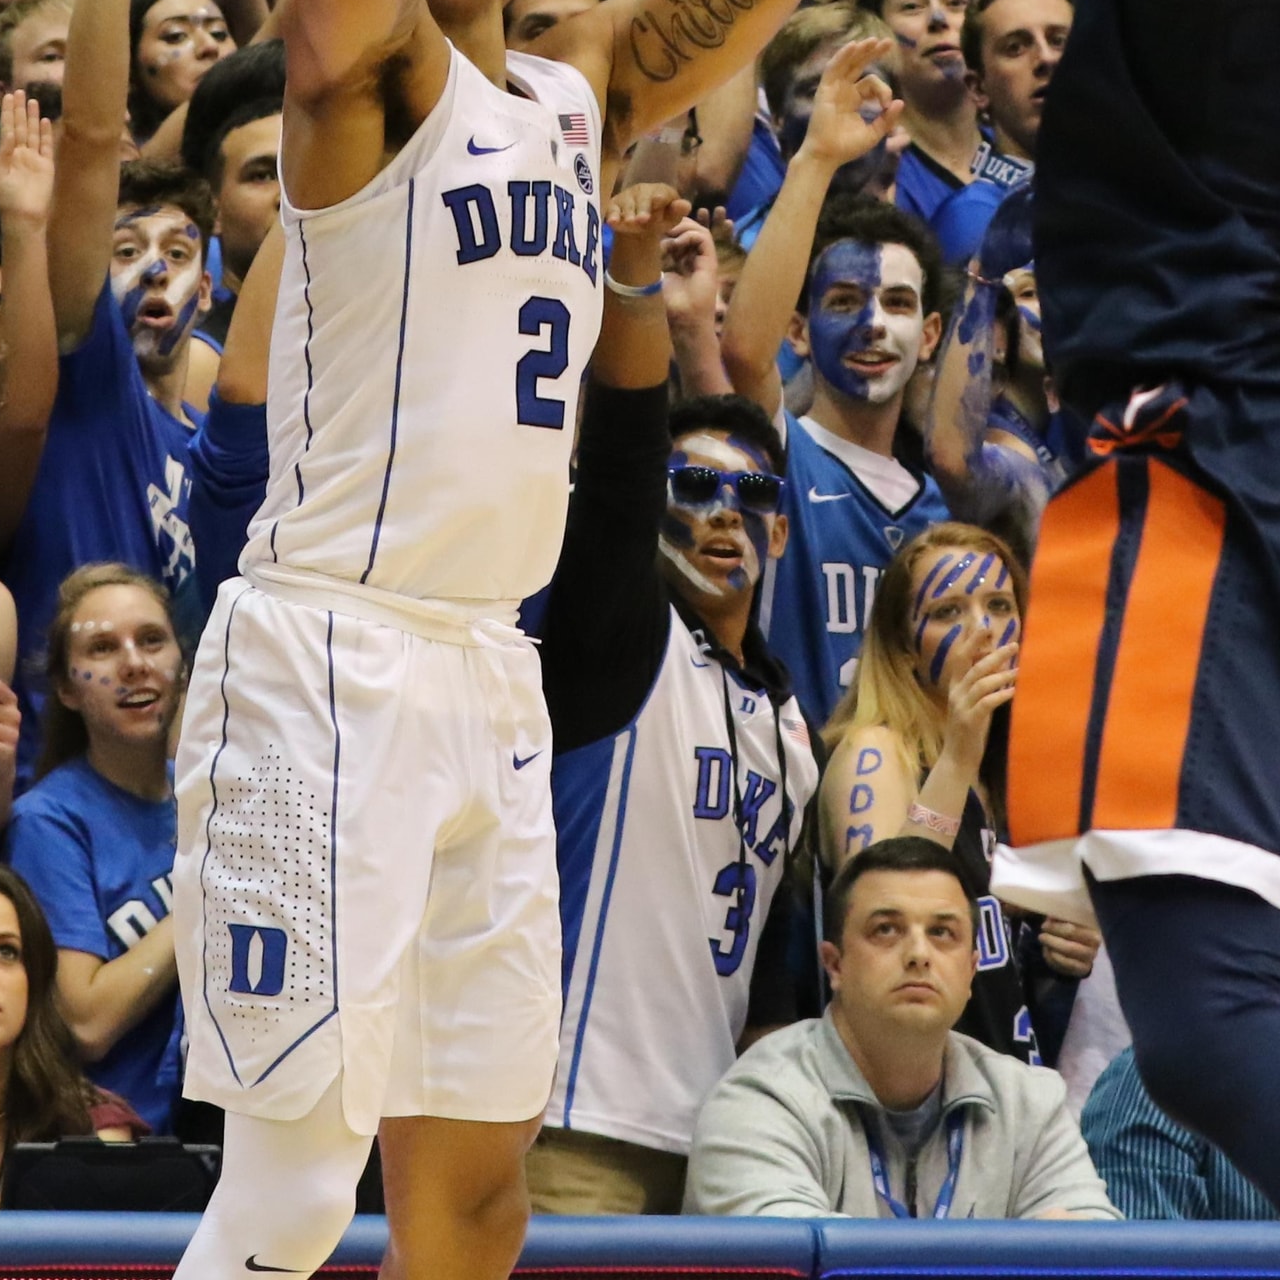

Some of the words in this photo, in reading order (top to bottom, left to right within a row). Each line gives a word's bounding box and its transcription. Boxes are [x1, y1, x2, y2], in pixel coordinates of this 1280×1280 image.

[441, 180, 600, 289] DUKE
[516, 296, 570, 430] 2
[228, 923, 288, 996] D
[708, 861, 756, 977] 3
